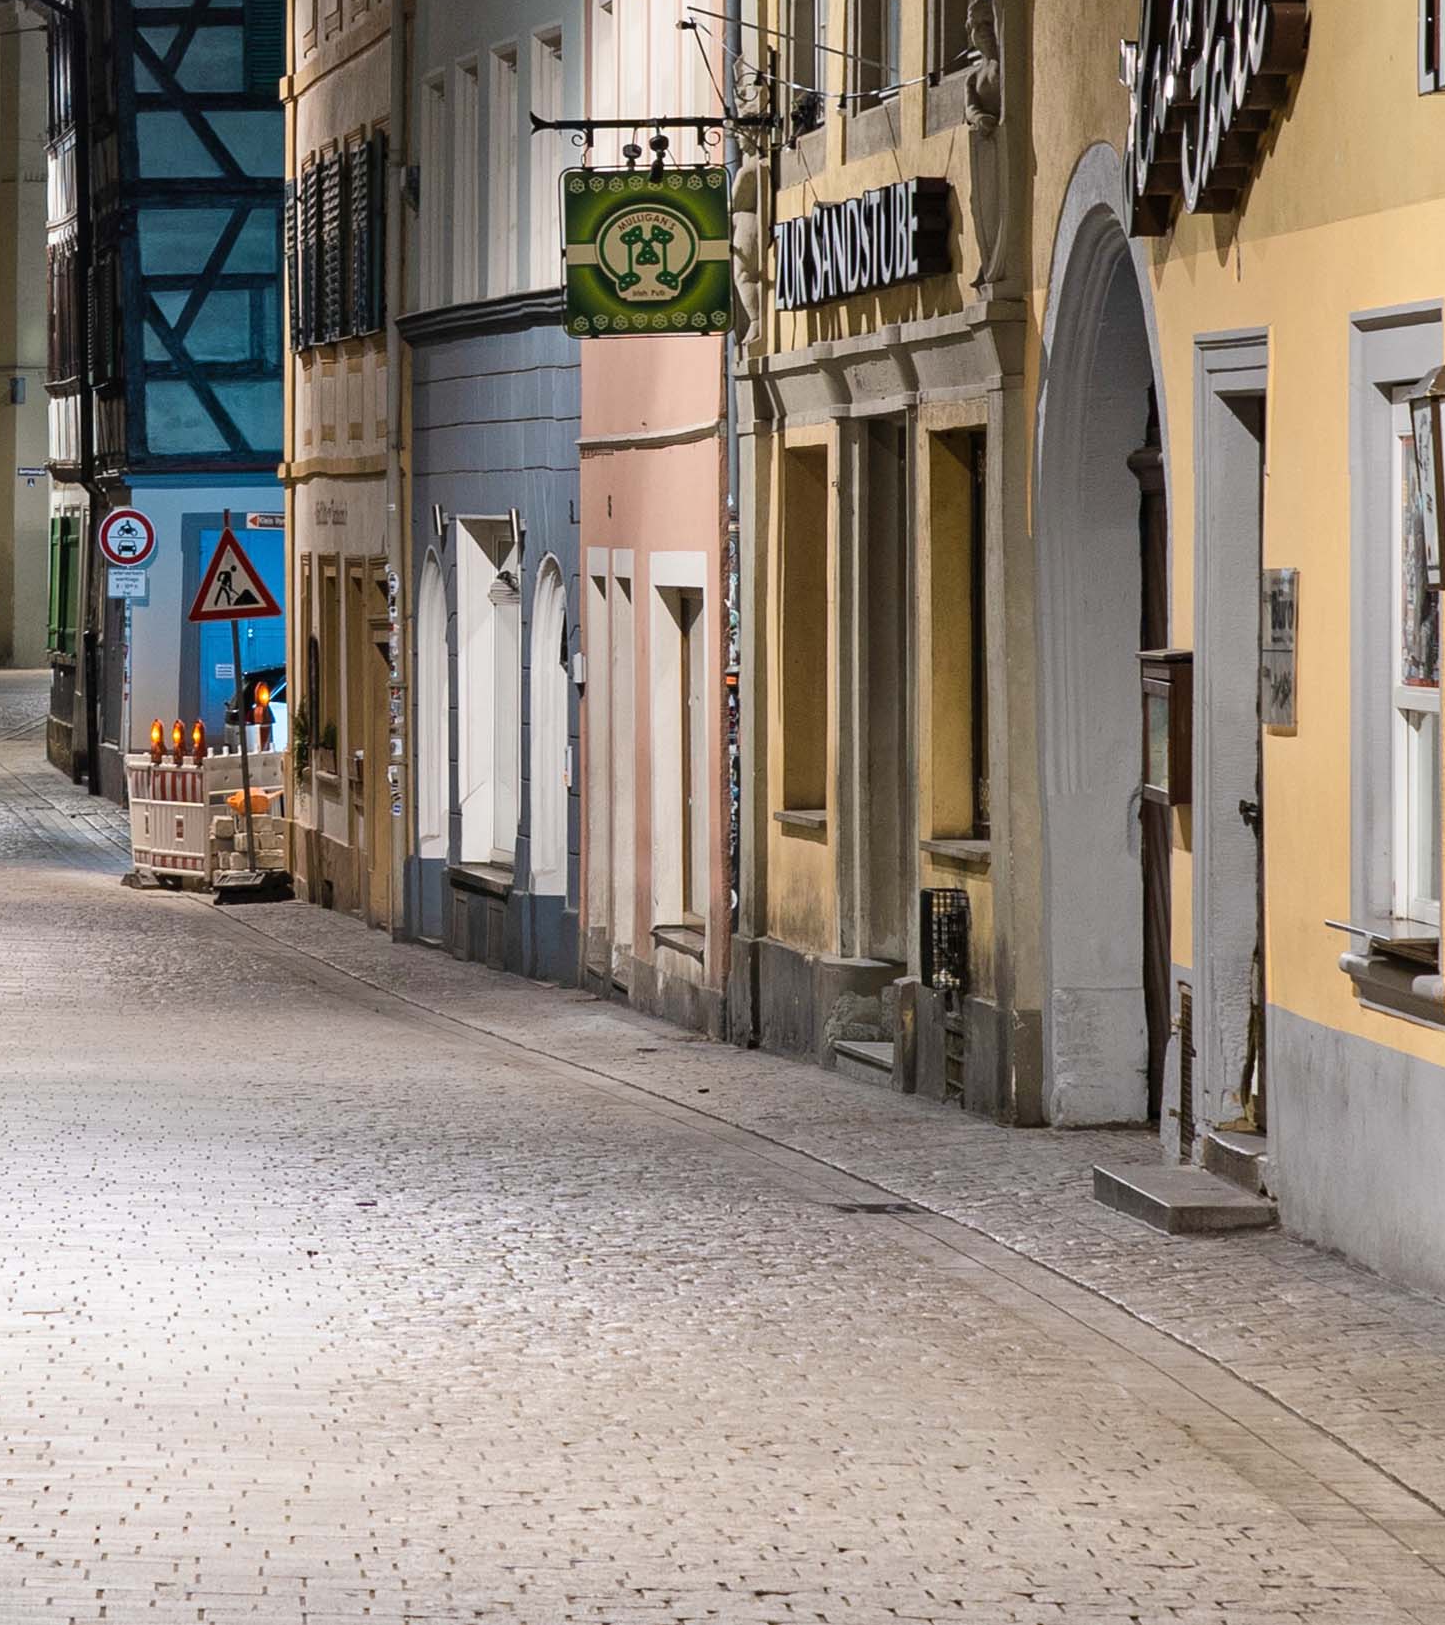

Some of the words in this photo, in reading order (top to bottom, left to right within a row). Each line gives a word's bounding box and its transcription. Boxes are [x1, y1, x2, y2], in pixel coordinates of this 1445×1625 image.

[618, 213, 677, 232] MULLIGAN'S
[774, 217, 807, 311] ZUR
[811, 178, 919, 304] SANDSTUBE
